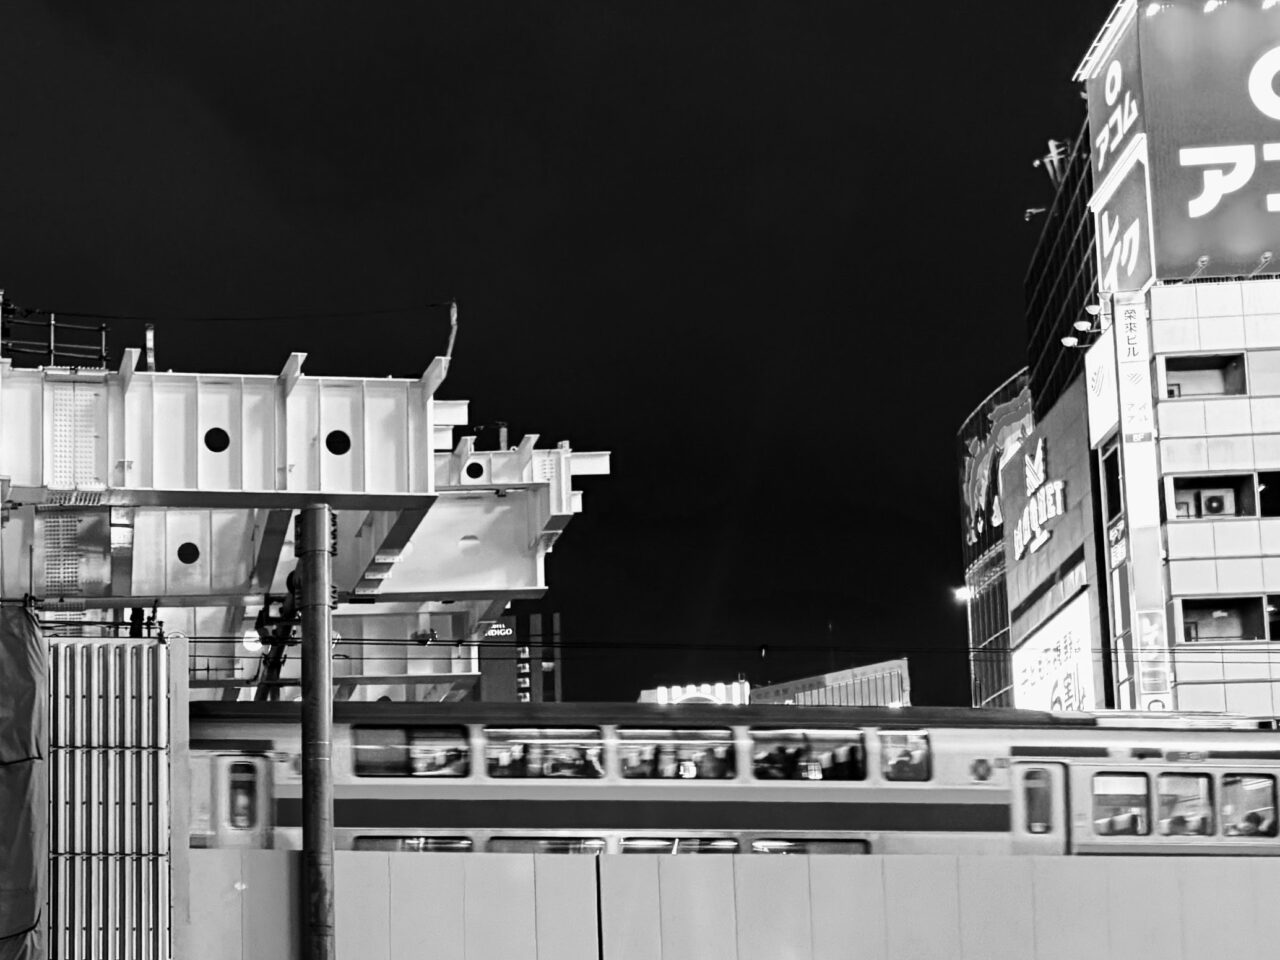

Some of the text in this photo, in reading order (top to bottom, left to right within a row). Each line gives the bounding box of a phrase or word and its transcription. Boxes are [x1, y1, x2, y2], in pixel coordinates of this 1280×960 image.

[1095, 89, 1140, 172] アコム
[1101, 210, 1140, 293] レイク
